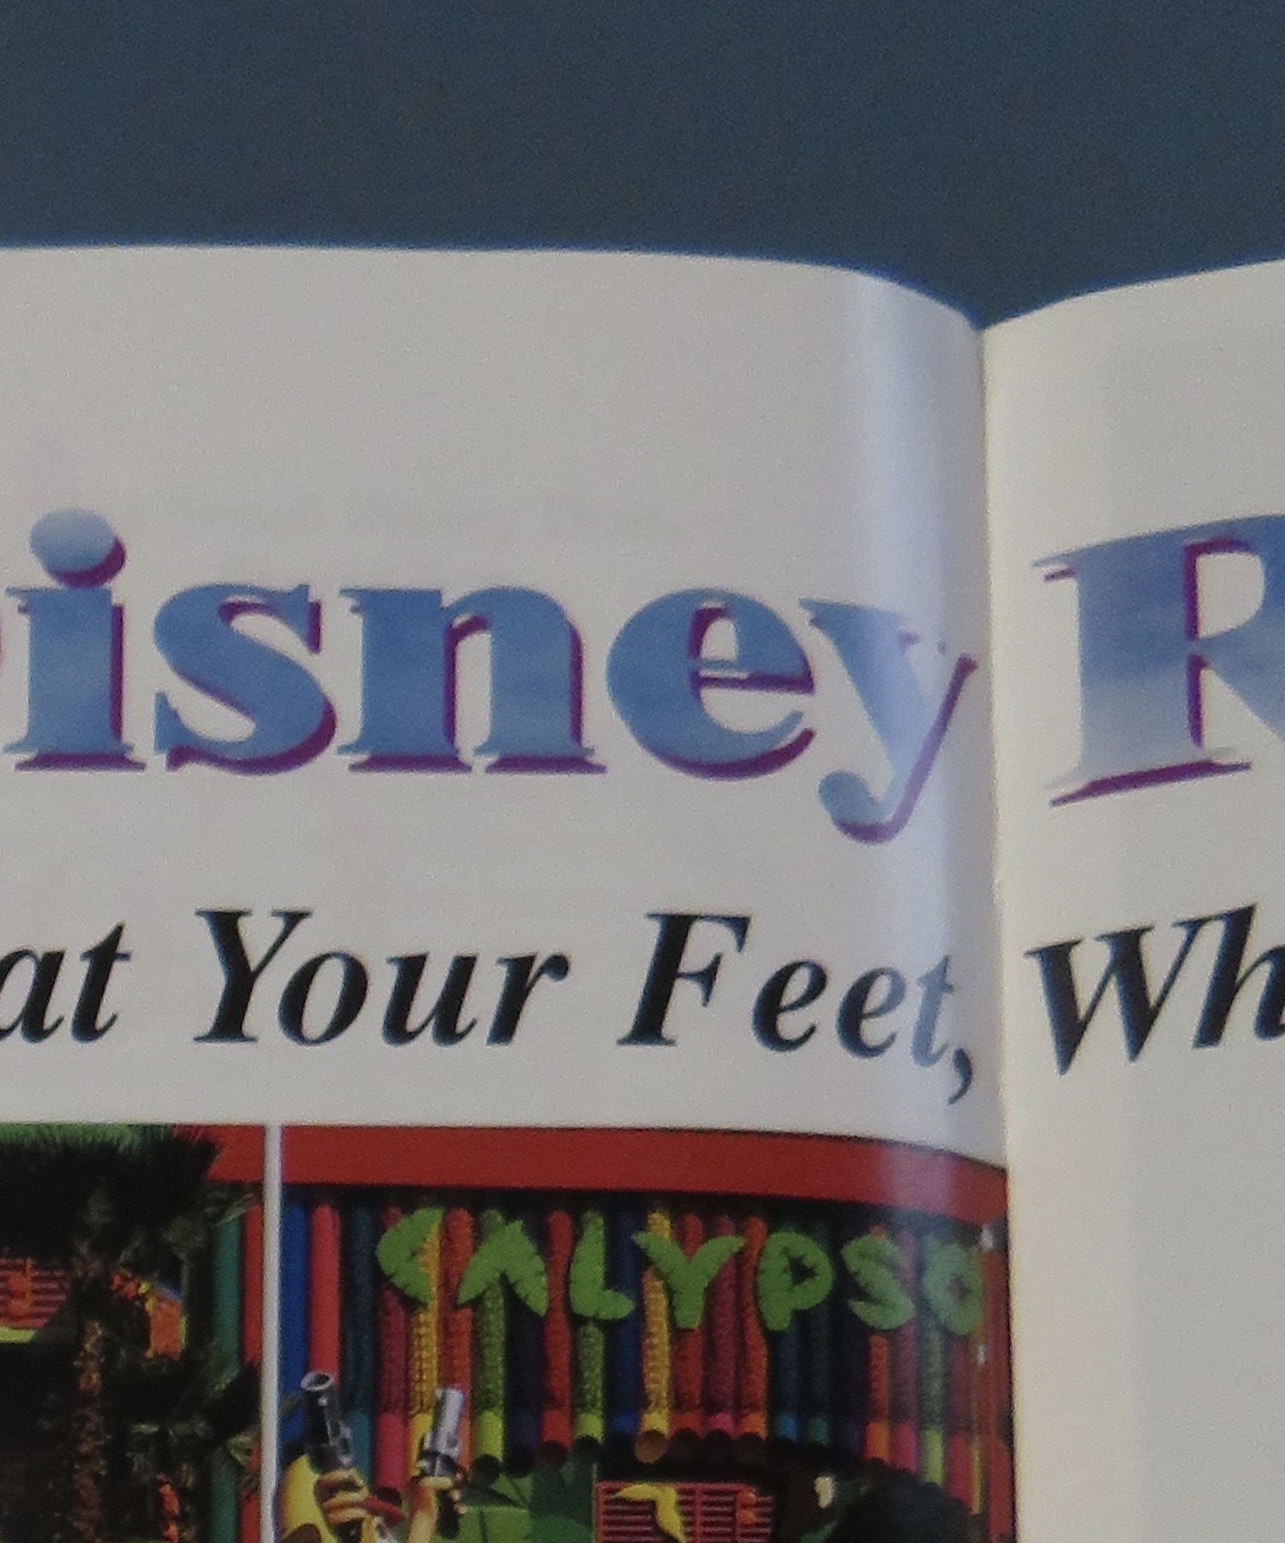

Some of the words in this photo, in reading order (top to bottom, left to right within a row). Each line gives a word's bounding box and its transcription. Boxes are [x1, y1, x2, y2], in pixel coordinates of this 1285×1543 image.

[194, 910, 570, 1046] Your
[617, 913, 973, 1104] Feet,
[375, 1205, 985, 1336] CALYPSO
